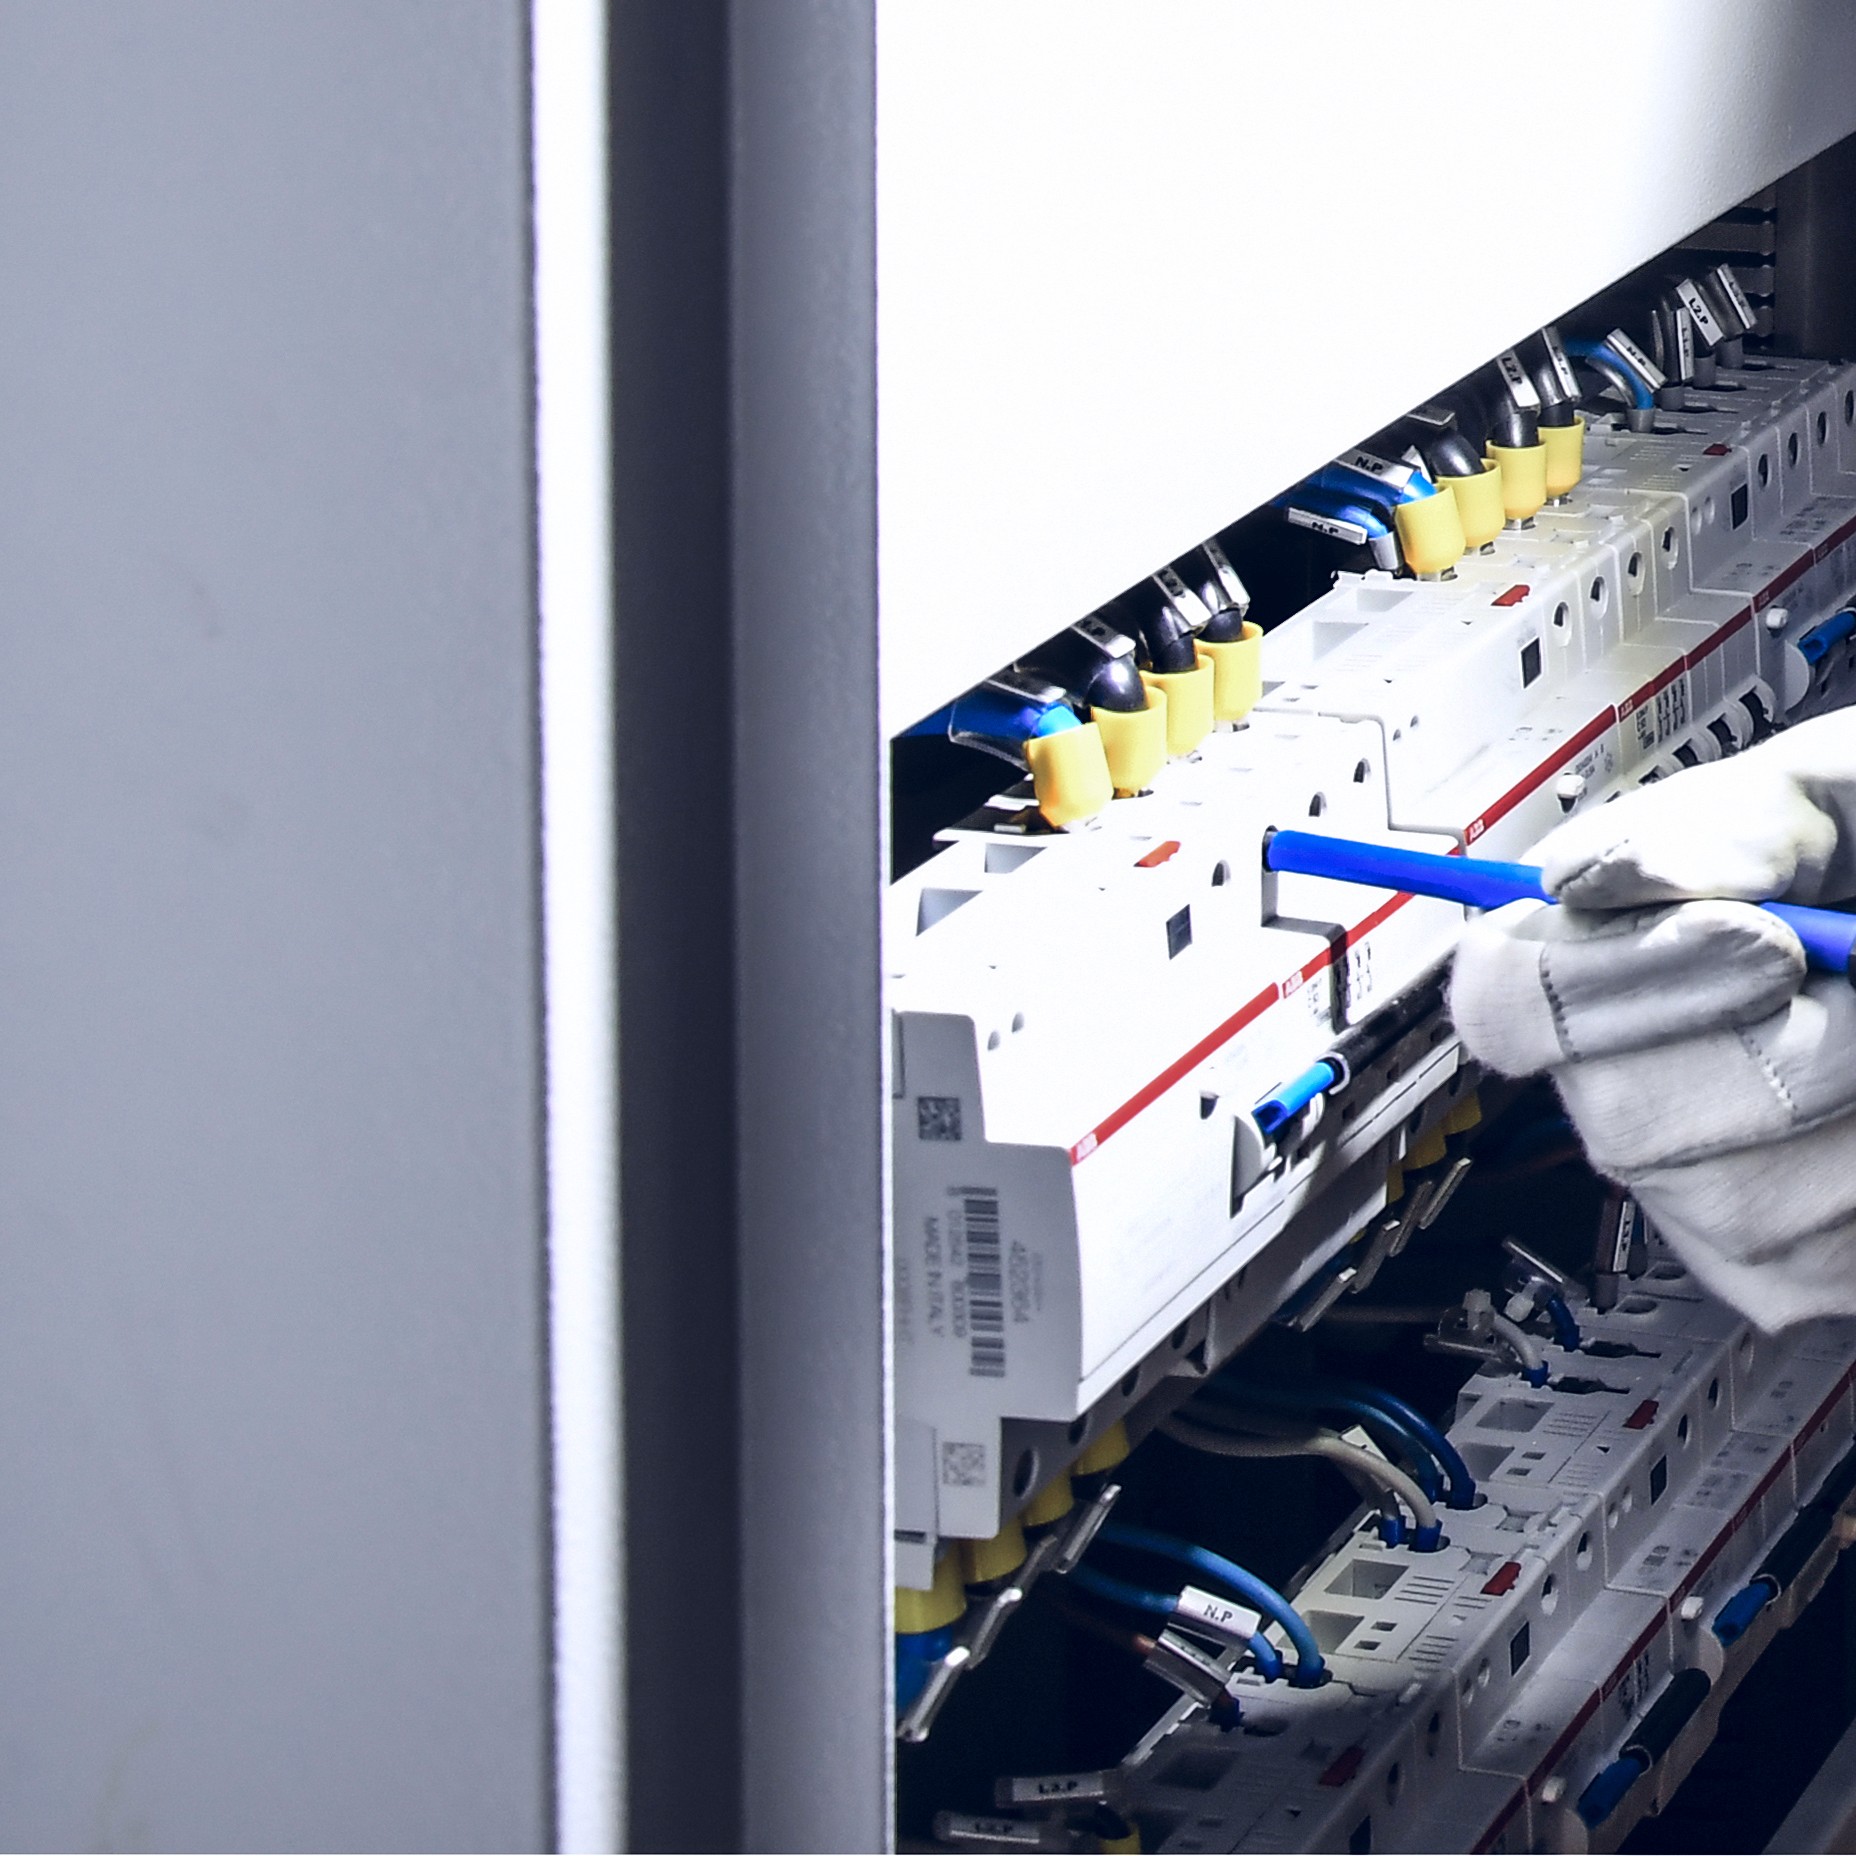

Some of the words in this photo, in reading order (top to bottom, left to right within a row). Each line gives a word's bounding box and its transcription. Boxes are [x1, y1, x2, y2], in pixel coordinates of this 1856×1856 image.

[1689, 298, 1709, 325] L2.P
[1502, 356, 1523, 385] L2.P
[1353, 455, 1384, 473] N.P
[1468, 819, 1485, 842] ABB
[1203, 1604, 1233, 1623] N.P
